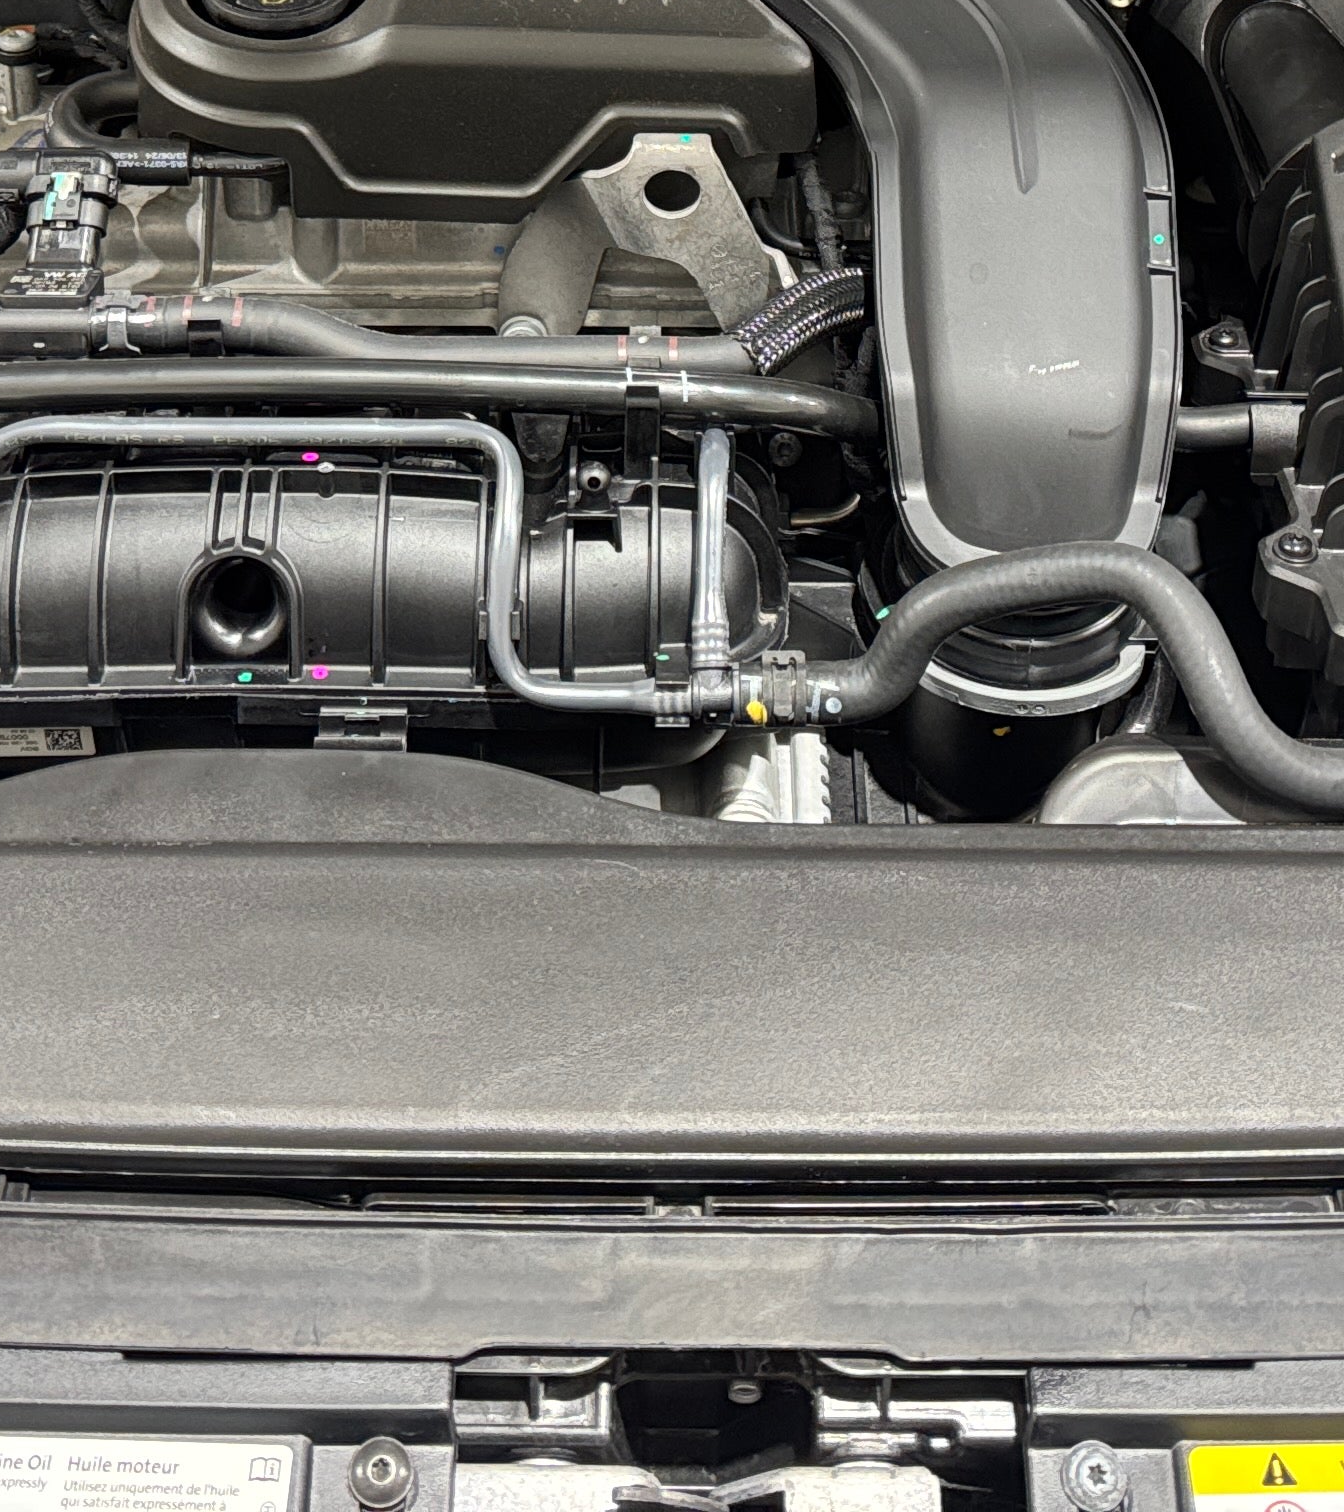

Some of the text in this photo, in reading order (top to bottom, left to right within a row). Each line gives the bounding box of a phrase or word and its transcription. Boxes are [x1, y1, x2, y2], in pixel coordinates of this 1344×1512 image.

[27, 1454, 52, 1471] Oil
[67, 1456, 180, 1475] Huile moteur
[63, 1480, 241, 1497] Utilisez uniquement de l'huile
[60, 1497, 80, 1511] qui
[81, 1496, 130, 1511] satisfait
